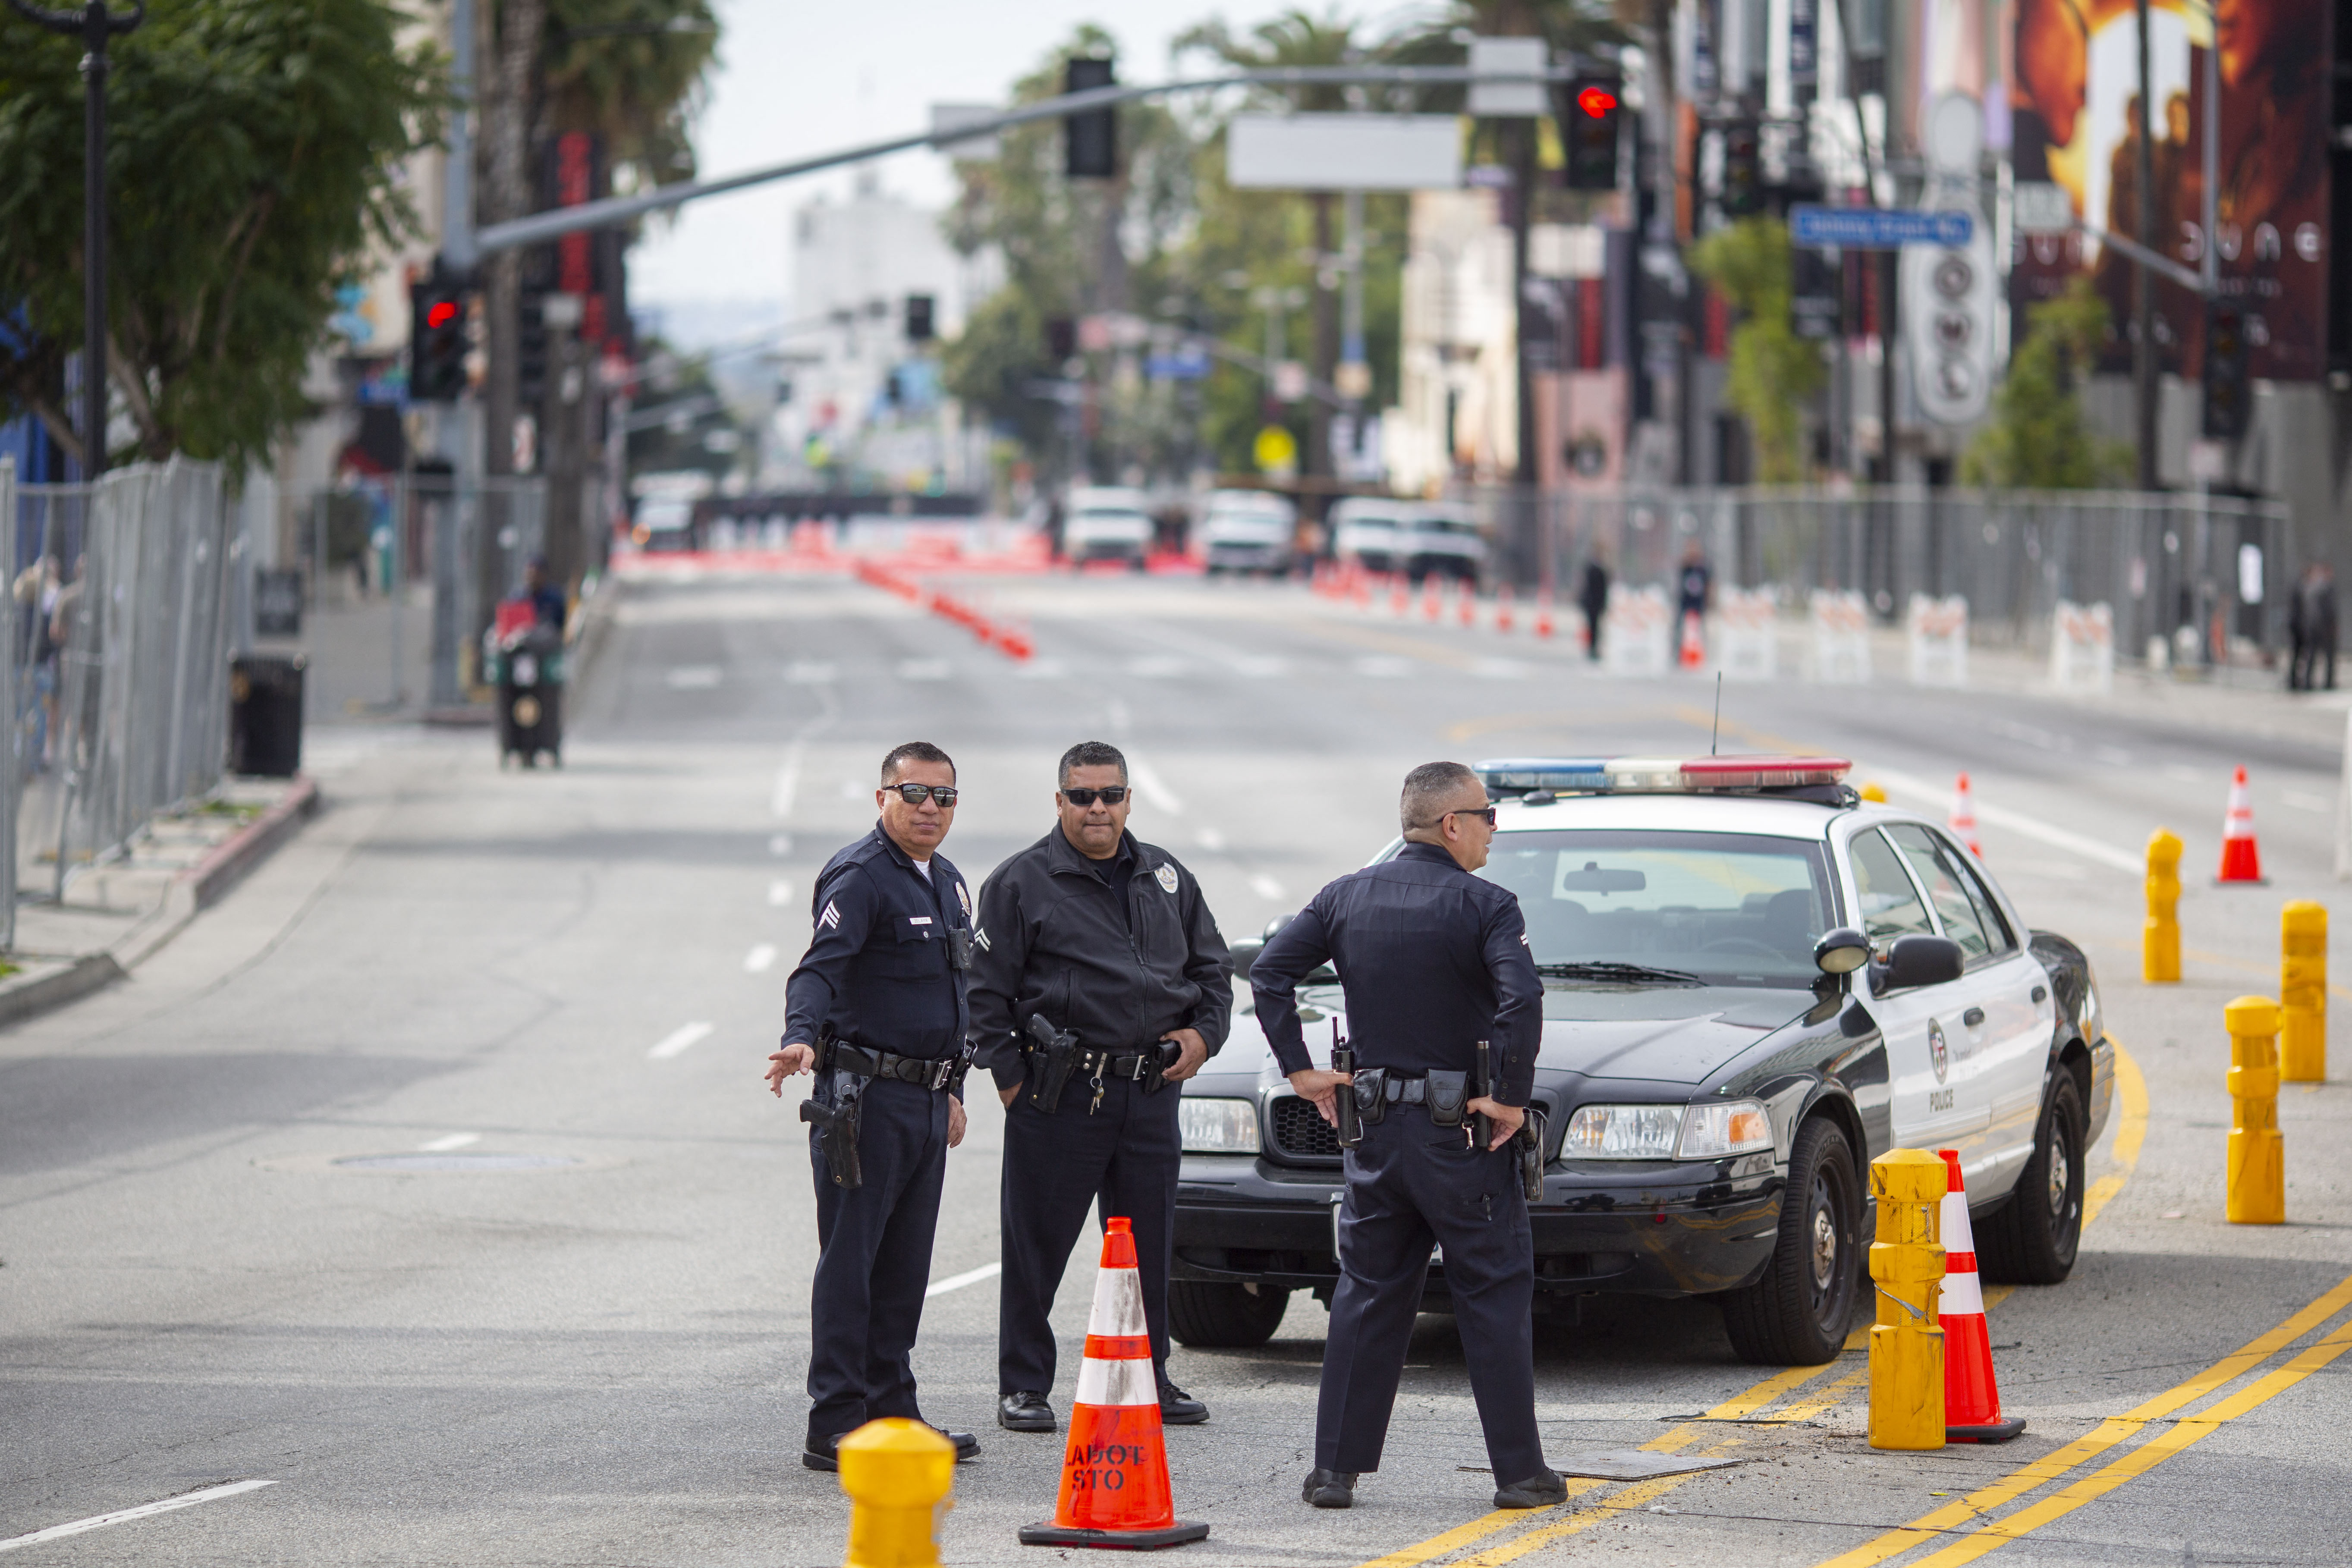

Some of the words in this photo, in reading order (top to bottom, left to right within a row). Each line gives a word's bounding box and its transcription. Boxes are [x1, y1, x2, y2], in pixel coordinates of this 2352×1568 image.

[1930, 1088, 1953, 1113] POLICE
[1068, 1445, 1145, 1465] ADOT
[1072, 1470, 1124, 1490] STO
